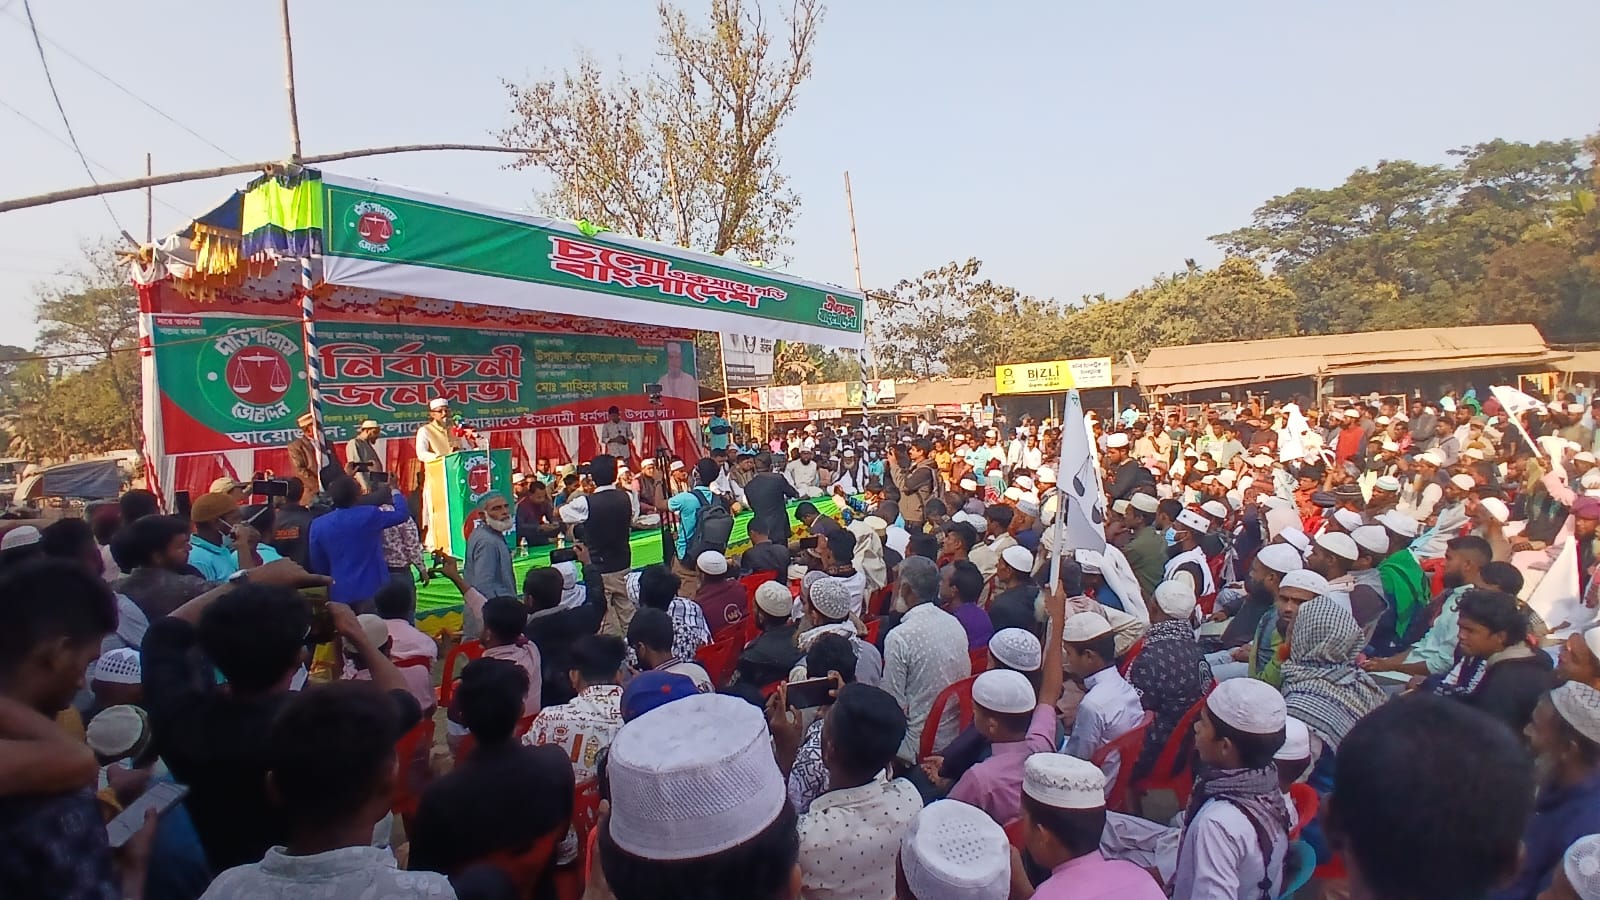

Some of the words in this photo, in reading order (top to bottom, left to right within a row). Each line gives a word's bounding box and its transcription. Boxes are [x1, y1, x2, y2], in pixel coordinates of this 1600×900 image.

[548, 235, 672, 277] চলো
[550, 259, 759, 309] বাংলাদেশ
[753, 285, 787, 301] গড়ি
[318, 342, 525, 379] নির্বাচনী
[320, 376, 523, 411] জনসভা
[524, 410, 576, 425] ইসলামী
